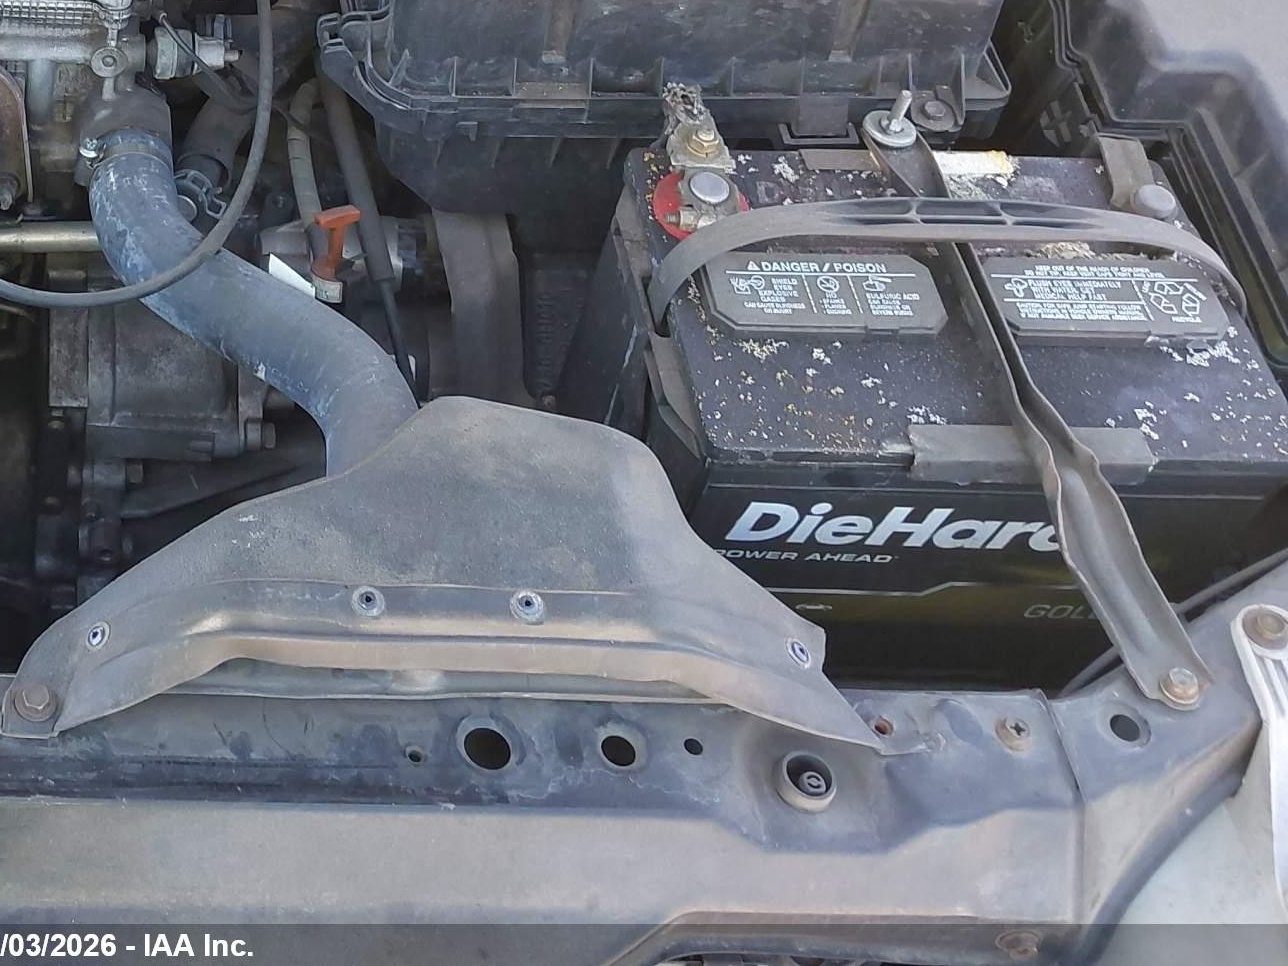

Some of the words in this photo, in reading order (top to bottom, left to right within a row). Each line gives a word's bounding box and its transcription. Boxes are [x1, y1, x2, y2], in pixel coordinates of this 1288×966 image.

[761, 261, 821, 272] DANGER
[832, 262, 887, 273] POISON
[1023, 603, 1094, 620] GOL
